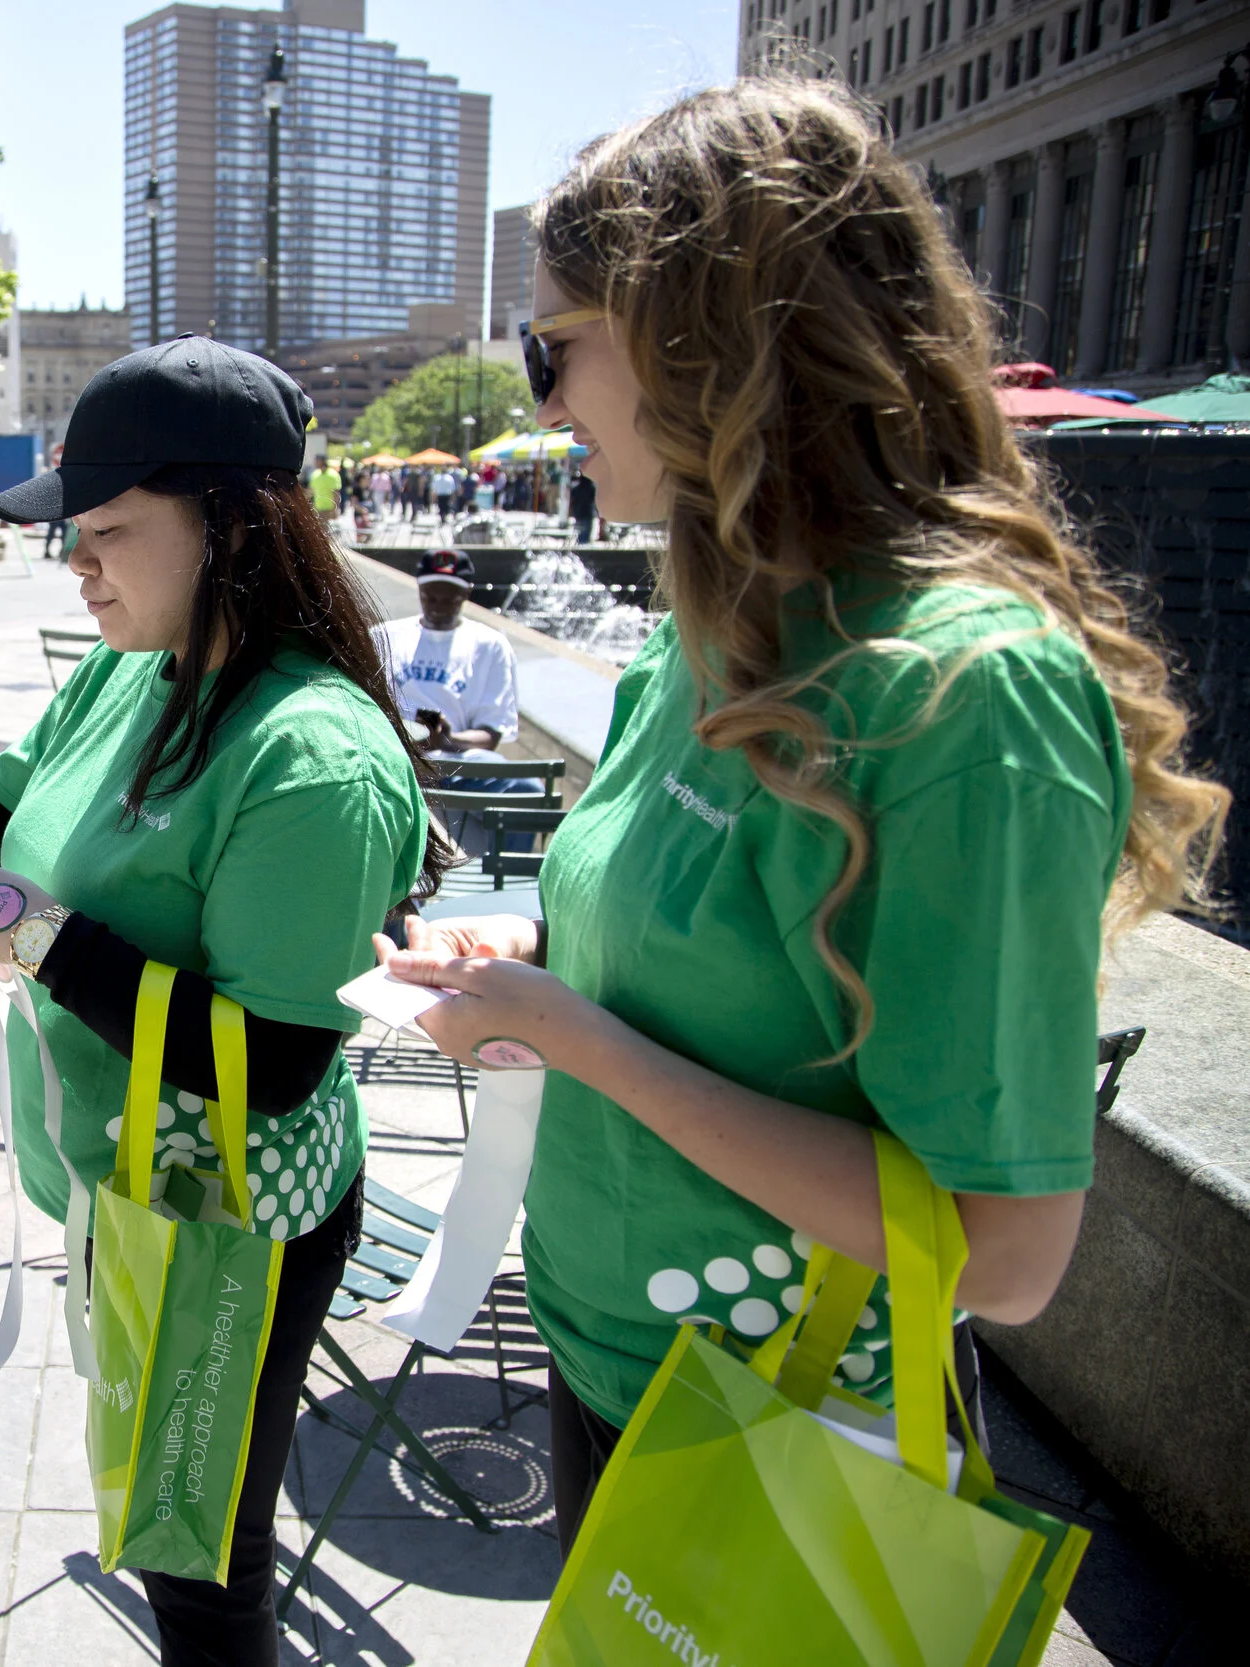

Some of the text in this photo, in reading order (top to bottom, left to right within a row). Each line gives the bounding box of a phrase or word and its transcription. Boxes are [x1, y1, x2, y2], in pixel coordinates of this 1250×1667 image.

[155, 1368, 197, 1521] to health care
[185, 1273, 243, 1503] A healthier approach
